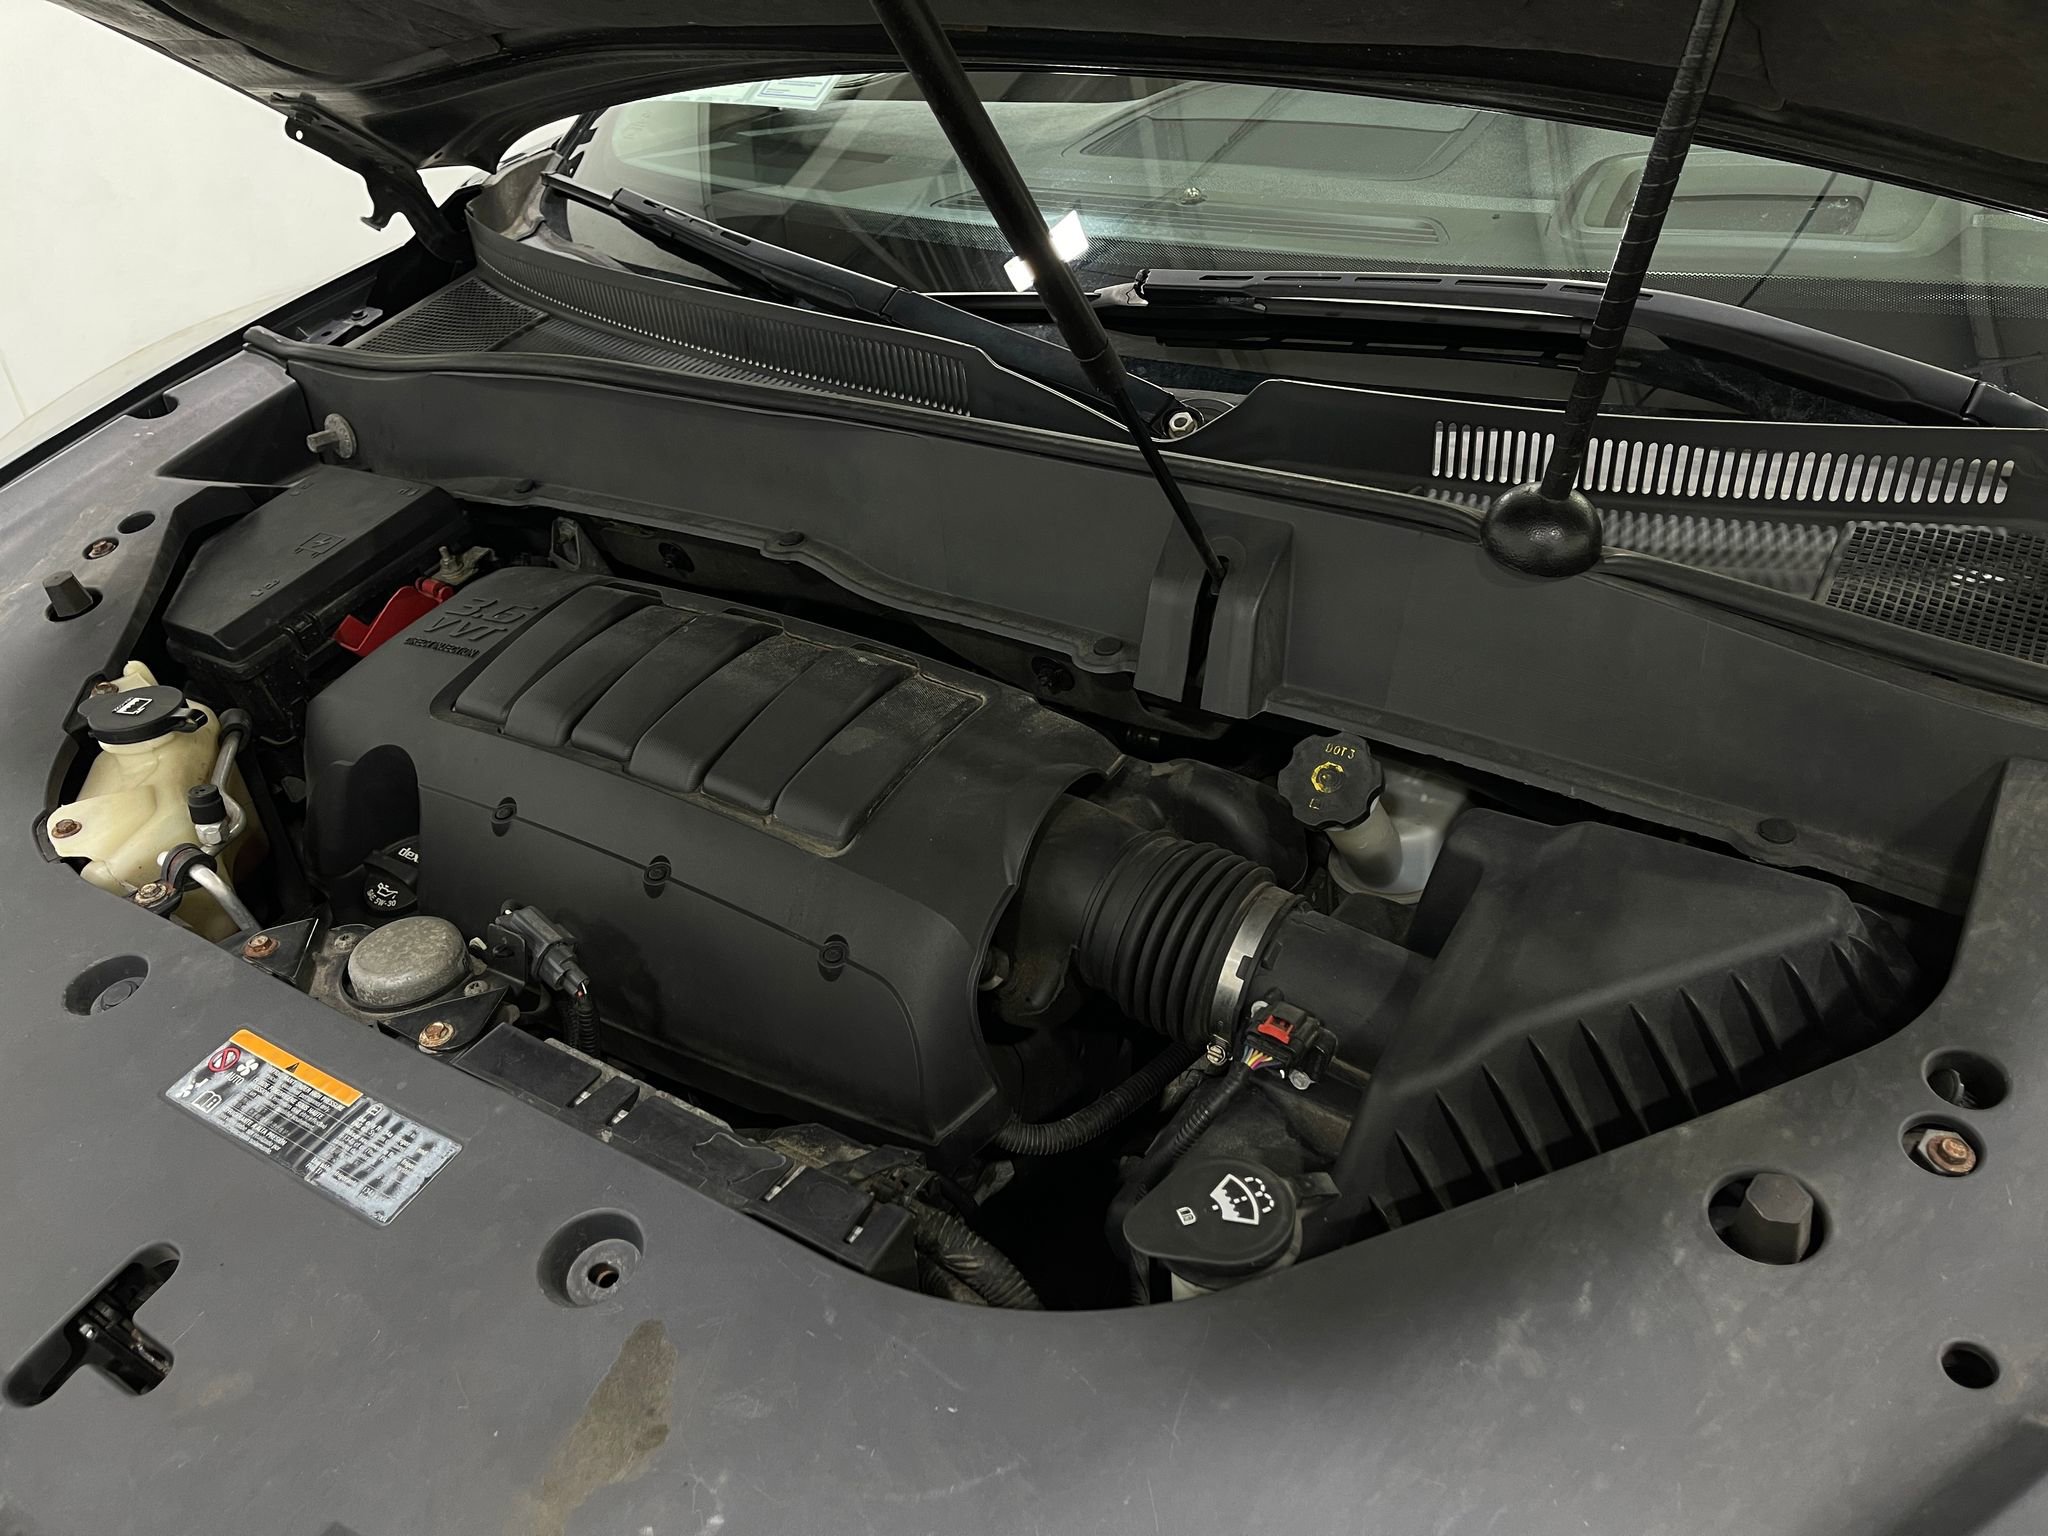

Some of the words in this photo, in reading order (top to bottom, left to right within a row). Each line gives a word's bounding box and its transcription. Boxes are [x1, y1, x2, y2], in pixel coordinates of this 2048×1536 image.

[444, 598, 539, 625] 3.6
[423, 616, 508, 642] VVT
[373, 897, 397, 907] 5W-30
[224, 1071, 245, 1086] AUTO
[319, 1095, 345, 1112] PRESSURE
